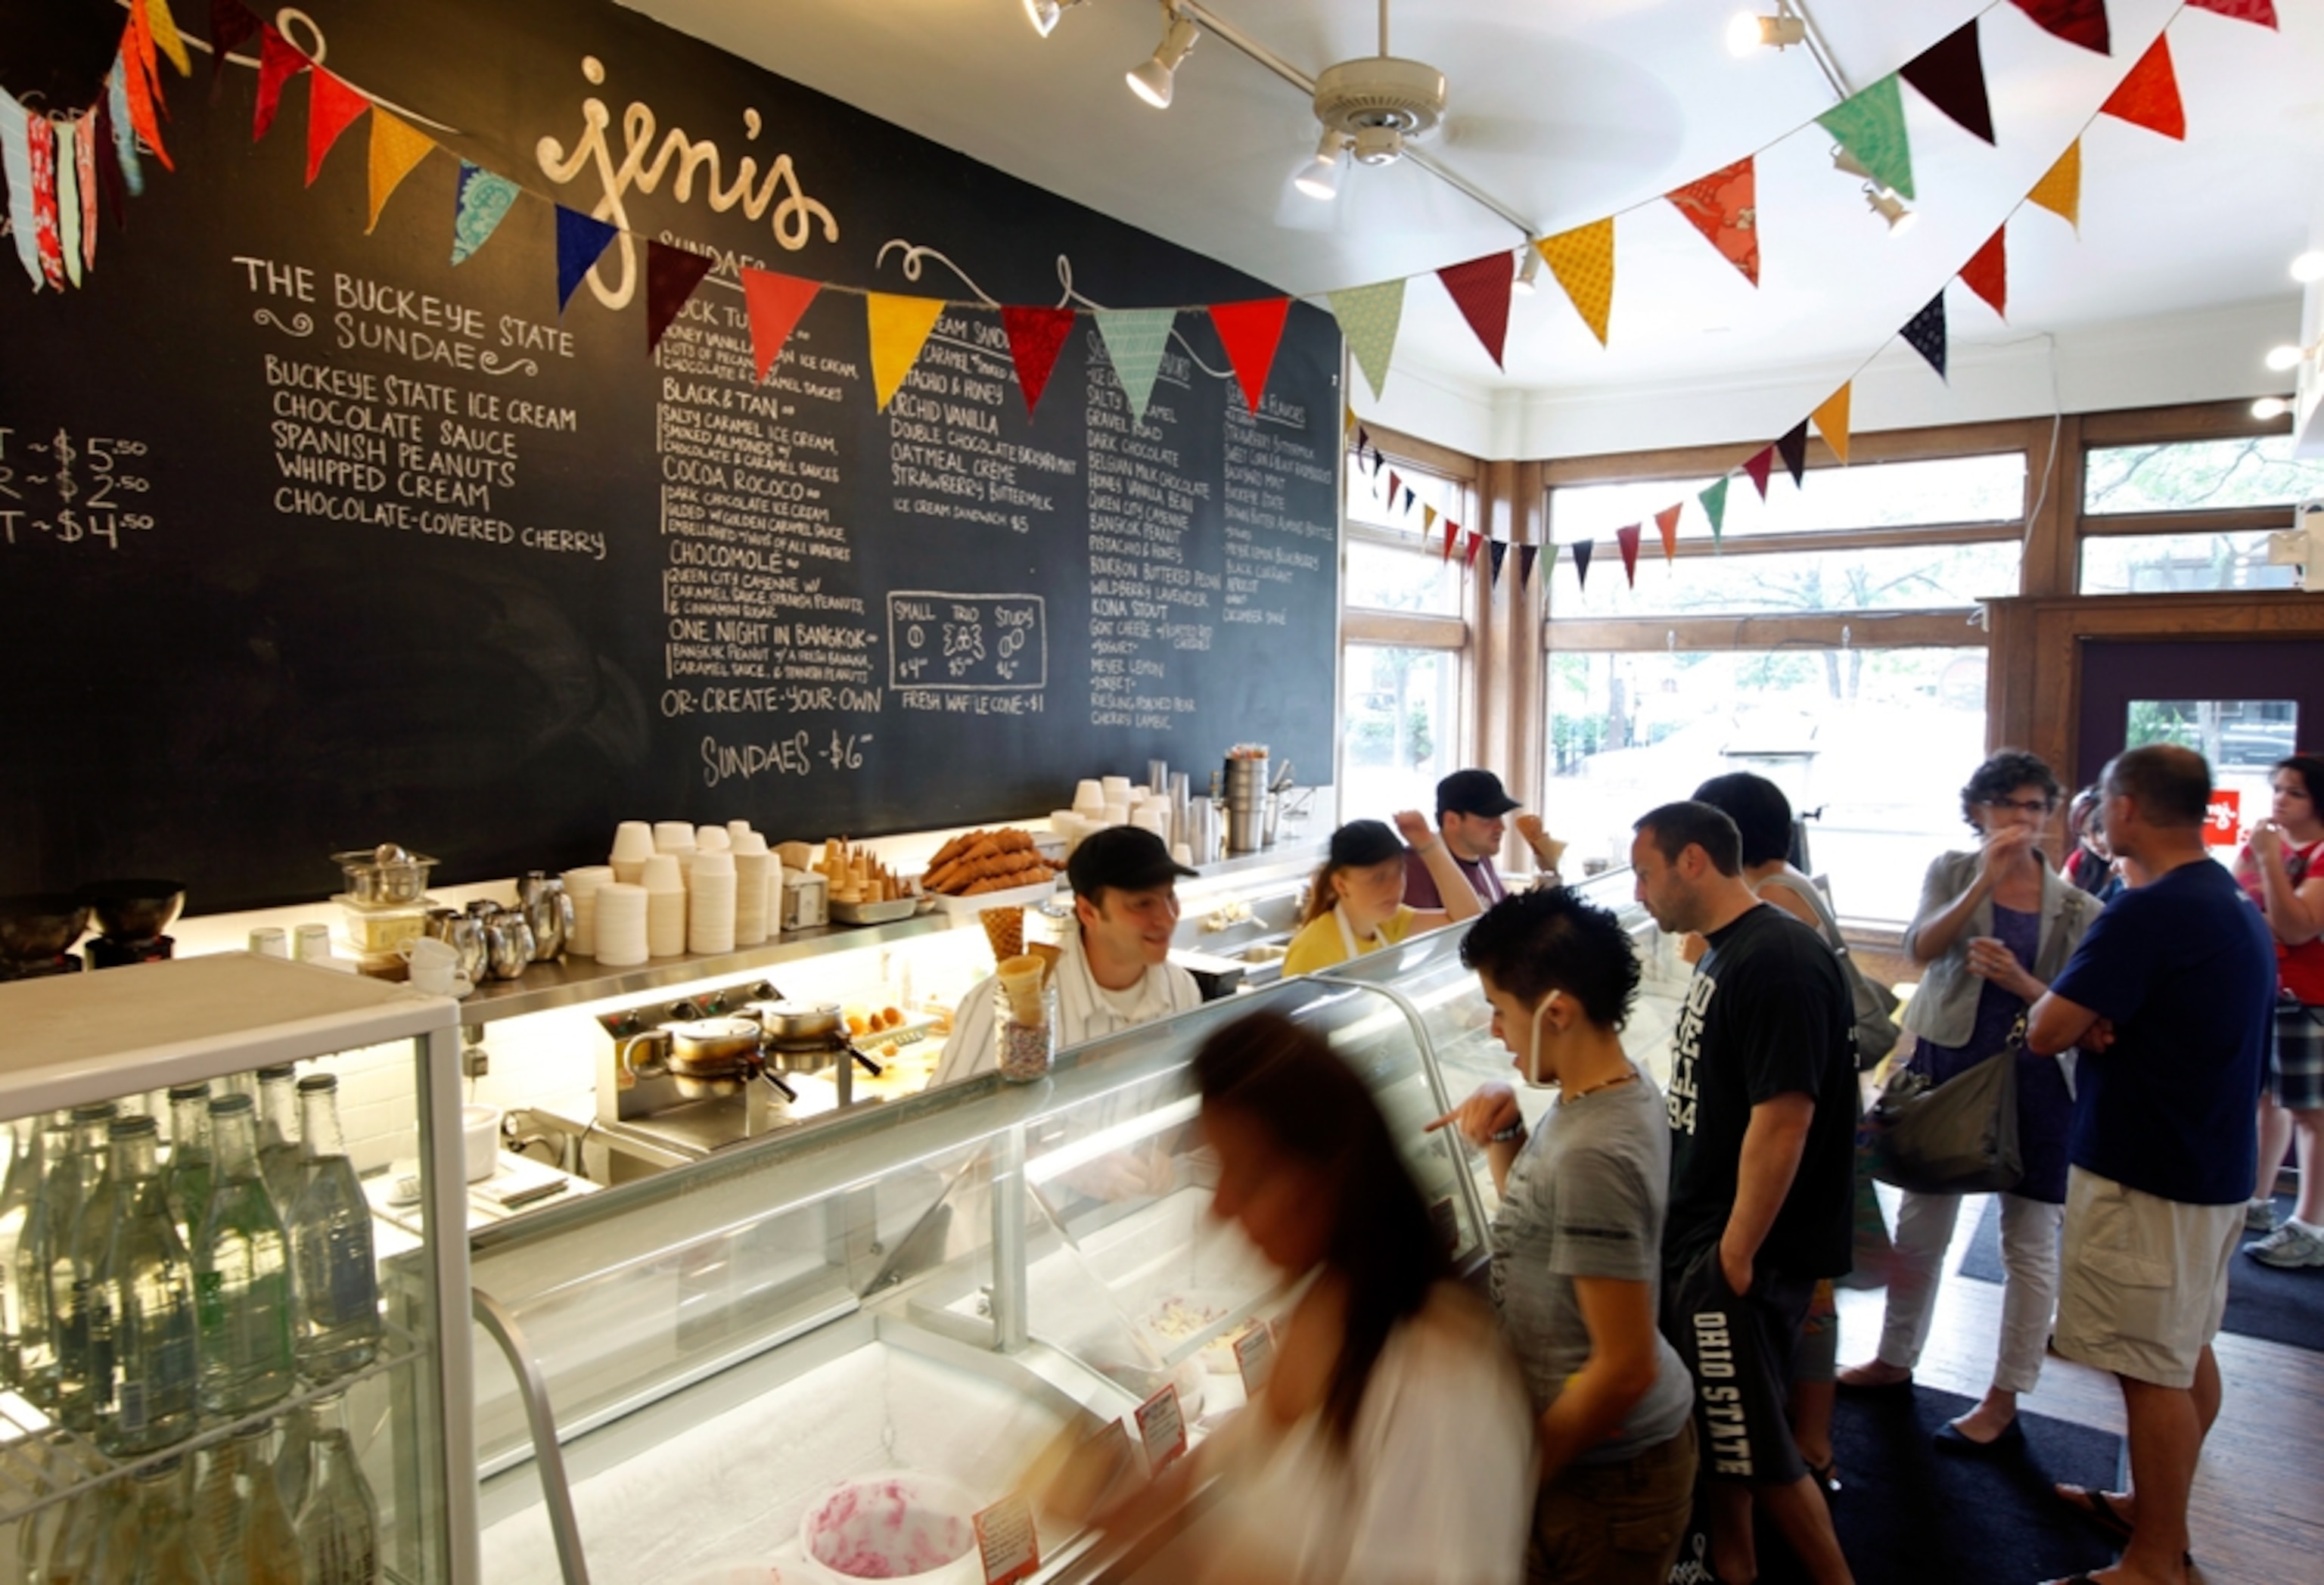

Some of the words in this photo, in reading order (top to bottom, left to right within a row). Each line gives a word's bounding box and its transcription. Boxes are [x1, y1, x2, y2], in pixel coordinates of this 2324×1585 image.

[536, 55, 839, 310] jeni's
[232, 256, 315, 302] THE
[335, 272, 484, 340] BUCKEYE
[499, 315, 574, 358] STATE
[334, 312, 475, 371] SUNDAE
[663, 340, 694, 360] LOTS
[265, 354, 377, 402] BUCKEYE
[385, 375, 458, 414] STATE
[468, 391, 499, 421] ICE
[508, 399, 576, 431] CREAM
[663, 377, 721, 406] BLACK
[722, 389, 732, 408] &
[737, 391, 778, 419] TAN
[964, 378, 1004, 406] HONEY
[1086, 385, 1122, 410] SALTY
[273, 391, 422, 443] CHOCOLATE
[440, 421, 517, 458] SAUCE
[663, 404, 701, 427] SALTY
[704, 413, 763, 438] CARAMEL
[769, 426, 789, 443] ICE
[943, 402, 999, 436] VANILLA
[272, 420, 386, 465] SPANISH
[399, 443, 515, 488] PEANUTS
[663, 424, 711, 443] SMOKED
[713, 435, 773, 457] ALMONDS
[890, 418, 943, 444] DOUBLE
[947, 430, 1017, 462] CHOCOLATE
[890, 443, 968, 474] OATMEAL
[1121, 438, 1179, 468] CHOCOLATE
[276, 452, 385, 492] WHIPPED
[398, 473, 489, 512] CREAM
[663, 456, 729, 489] COCOA
[734, 470, 803, 501] ROCOCO
[891, 462, 985, 502] STRAWBERRY
[989, 481, 1055, 512] BUTTERMILK
[703, 492, 770, 514] CHOCOLATE
[723, 511, 766, 530] GOLDEN
[892, 498, 910, 513] ICE
[914, 499, 951, 517] CREAM
[275, 487, 514, 544] CHOCOLATE-COVERED
[521, 528, 606, 560] CHERRY
[670, 585, 729, 601] CARAMEL
[711, 571, 738, 586] CITY
[894, 601, 937, 621] SMALL
[669, 619, 710, 642] ONE
[716, 621, 769, 644] NIGHT
[773, 626, 790, 645] IN
[796, 623, 866, 648] BANGKOK
[903, 690, 942, 710] FRESH
[701, 730, 810, 788] SUNDAES
[1693, 1311, 1735, 1378] OHIO
[1702, 1387, 1753, 1475] STATE
